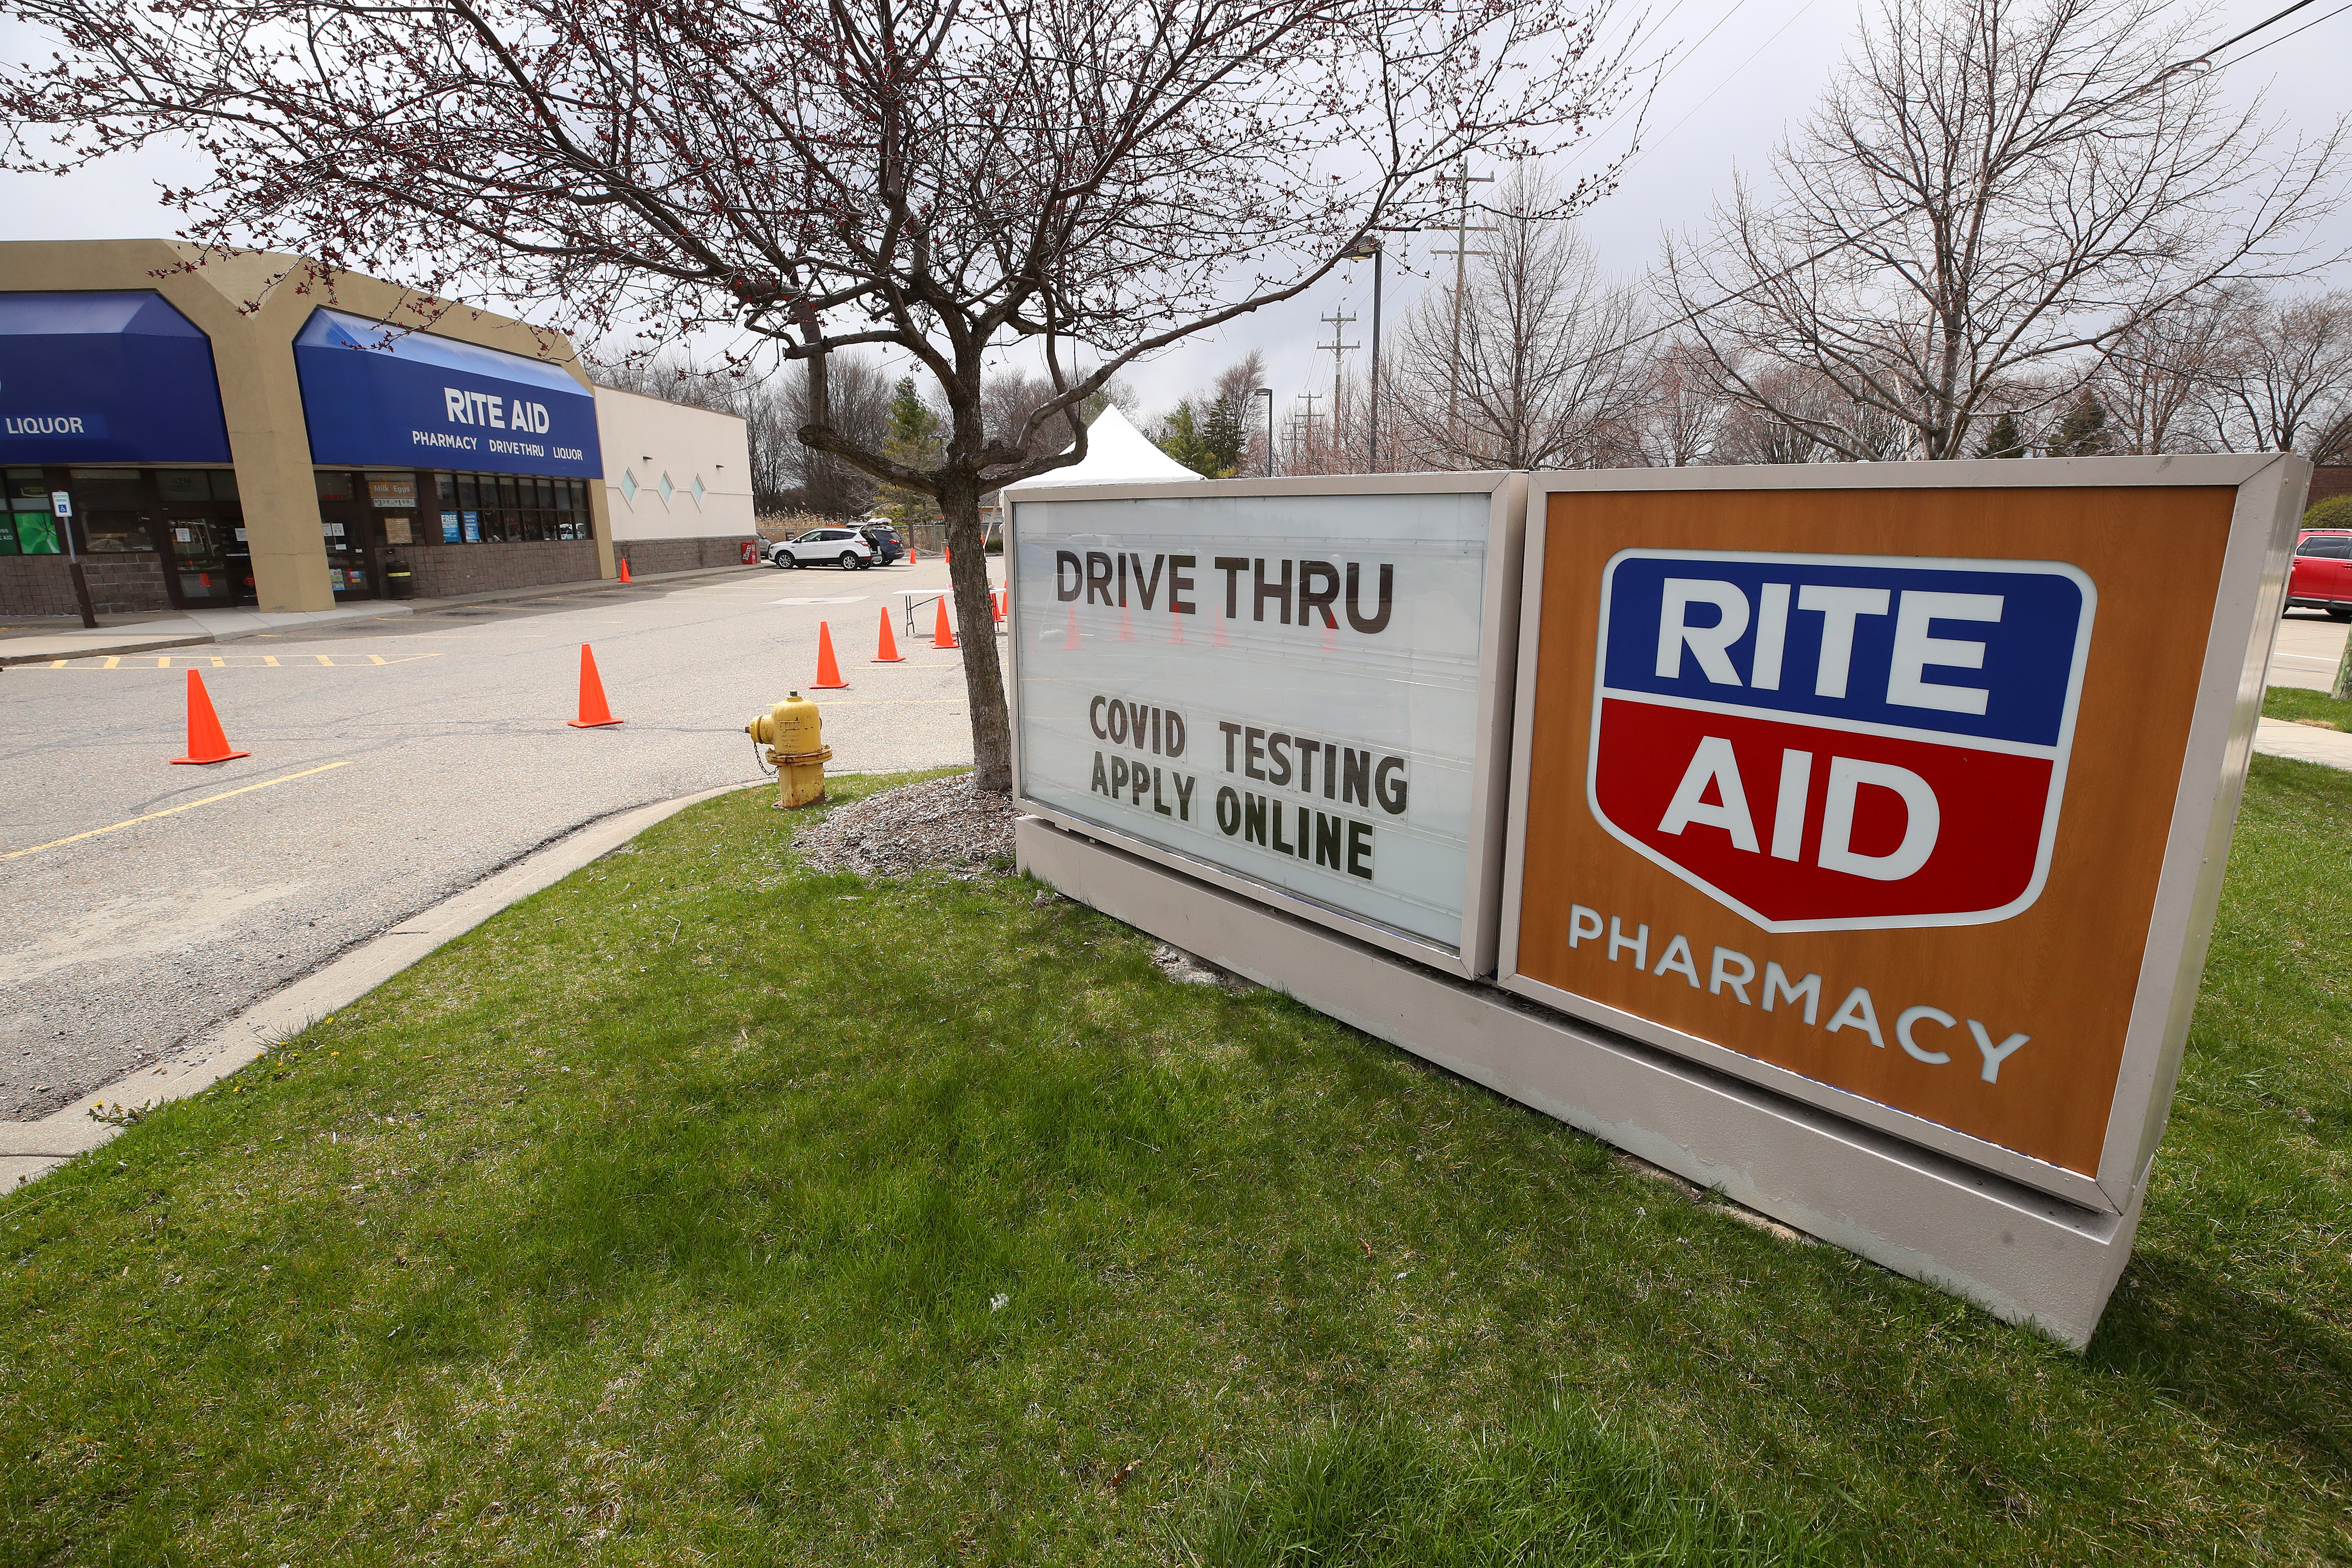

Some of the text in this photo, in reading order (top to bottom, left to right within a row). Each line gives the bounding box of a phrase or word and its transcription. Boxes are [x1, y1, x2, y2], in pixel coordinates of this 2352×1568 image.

[6, 417, 85, 434] LIQUOR
[412, 430, 477, 450] PHARMACY
[553, 447, 583, 461] LIQUOR
[444, 387, 550, 434] RITE AID
[1056, 550, 1393, 634] DRIVE THRU
[1656, 578, 2004, 715] RITE
[1090, 695, 1407, 815] COVID TESTING
[1657, 735, 1940, 881] AID
[1091, 751, 1373, 881] APPLY ONLINE
[1568, 903, 2031, 1084] PHARMACY
